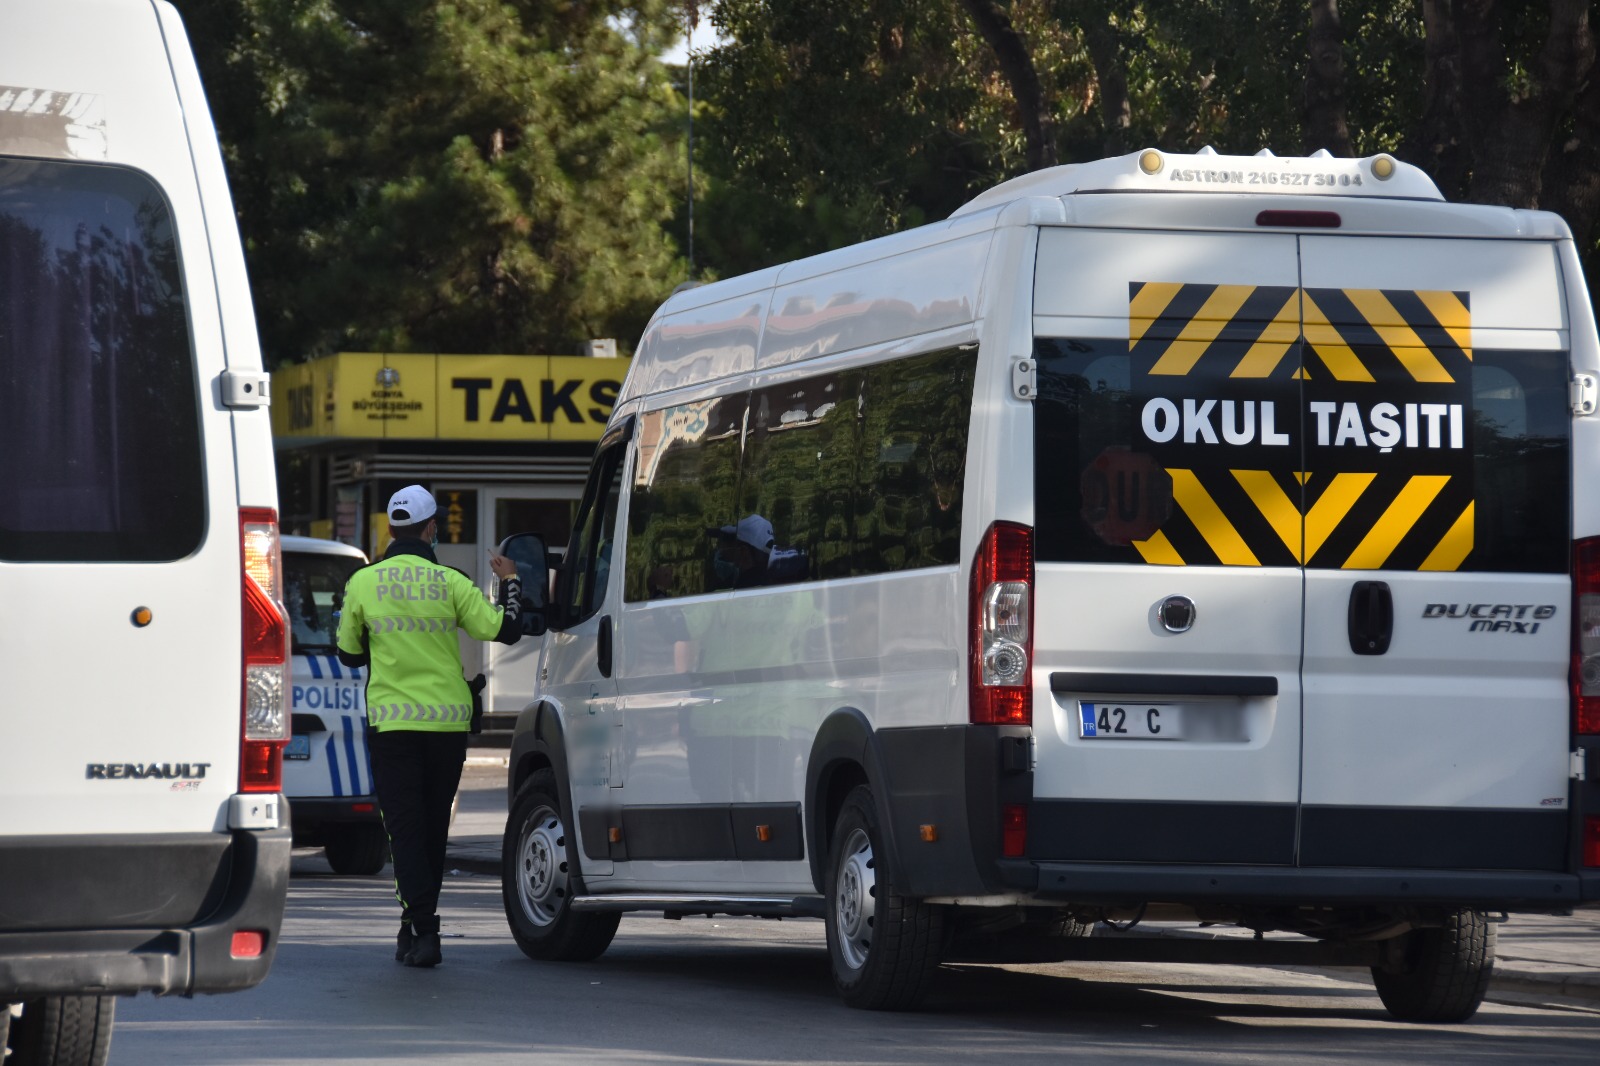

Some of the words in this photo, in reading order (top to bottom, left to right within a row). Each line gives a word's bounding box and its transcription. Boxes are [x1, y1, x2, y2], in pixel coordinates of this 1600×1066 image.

[1170, 169, 1244, 184] ASTRON
[371, 390, 403, 399] KONYA
[1141, 397, 1290, 446] OKUL
[1310, 401, 1464, 453] TAŞITI
[375, 566, 447, 583] TRAFİK
[376, 583, 448, 602] POLİSİ
[1421, 603, 1557, 620] DUCATO
[1468, 620, 1541, 634] MAXI
[292, 682, 359, 710] POLİSİ
[1083, 722, 1096, 731] TR
[1097, 707, 1128, 734] 42
[1147, 708, 1161, 734] C
[85, 763, 212, 780] RENAULT
